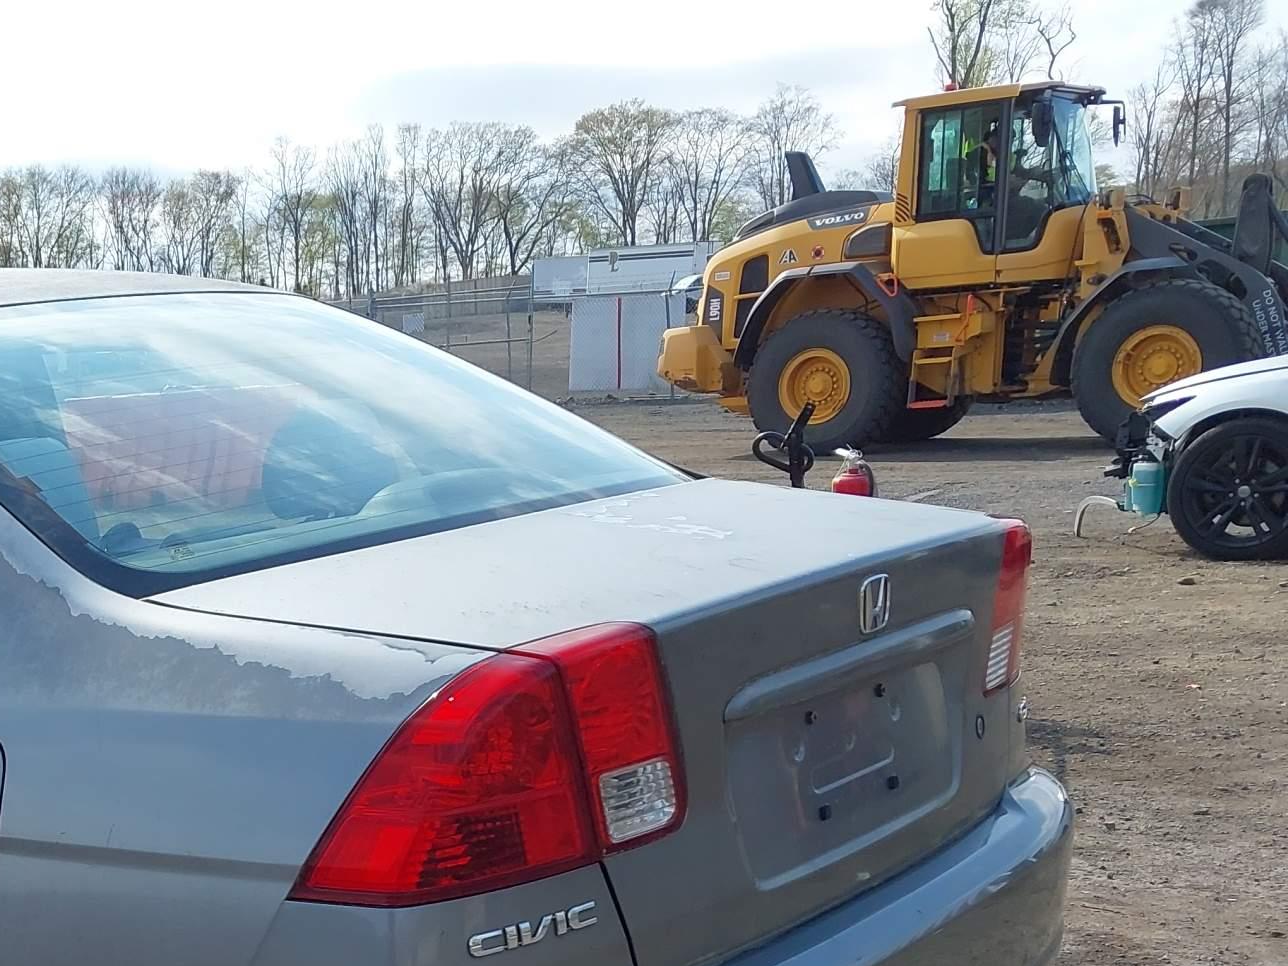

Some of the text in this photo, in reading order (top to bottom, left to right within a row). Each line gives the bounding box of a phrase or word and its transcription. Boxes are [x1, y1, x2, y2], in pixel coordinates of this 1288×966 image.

[815, 212, 865, 226] VOLVO
[1263, 289, 1274, 305] DO
[709, 298, 721, 321] L90H
[1252, 300, 1269, 333] UNDER
[1268, 306, 1281, 328] NOT
[468, 900, 598, 957] CIVIC
